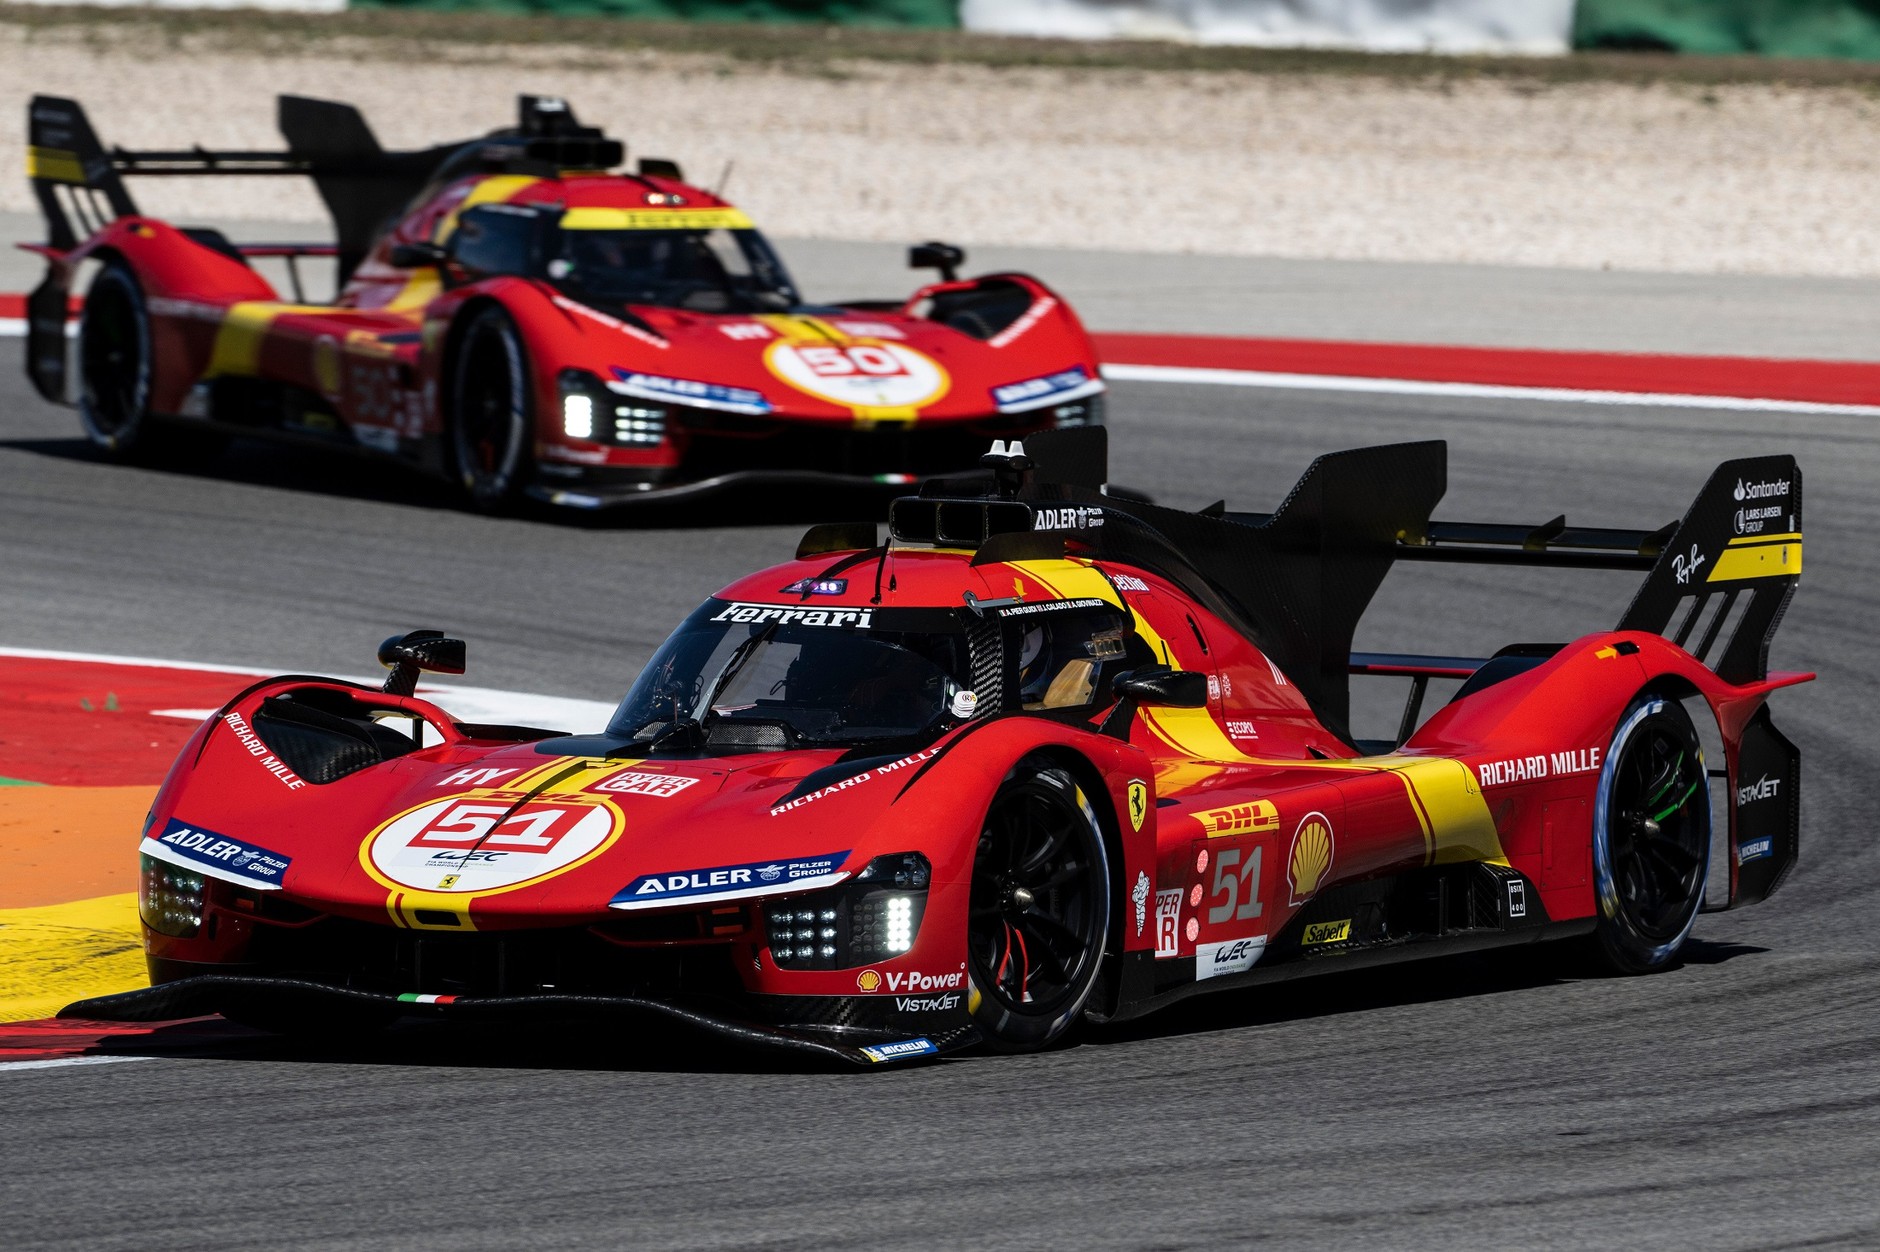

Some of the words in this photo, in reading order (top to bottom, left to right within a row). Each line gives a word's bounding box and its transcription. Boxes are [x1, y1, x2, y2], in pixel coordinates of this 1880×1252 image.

[800, 347, 902, 376] 50
[1746, 479, 1790, 499] Santander
[1034, 508, 1077, 530] ADLER
[1746, 509, 1760, 520] LARS
[1760, 506, 1782, 518] LARSEN
[1745, 521, 1764, 533] GROUP
[710, 601, 874, 629] Ferrari
[224, 711, 267, 758] RICHARD
[259, 754, 306, 790] MILLE
[1479, 755, 1547, 787] RICHARD
[1550, 747, 1600, 776] MILLE
[604, 780, 679, 795] CAR
[620, 773, 692, 786] HYPER
[770, 772, 872, 817] RICHARD
[421, 804, 567, 847] 51
[1209, 804, 1270, 832] DHL
[162, 828, 242, 861] ADLER
[259, 855, 288, 869] PELZER
[431, 850, 510, 862] WEC
[788, 861, 832, 870] PELZER
[248, 862, 277, 876] GROUP
[788, 867, 832, 878] GROUP
[635, 869, 752, 895] ADLER
[1208, 845, 1264, 924] 51
[1156, 893, 1180, 915] PER
[1306, 921, 1346, 943] Sabelt
[1214, 941, 1251, 963] WEC
[885, 971, 963, 992] V-Power
[895, 991, 960, 1012] VISTAJET
[880, 1040, 930, 1054] MICHELIN
